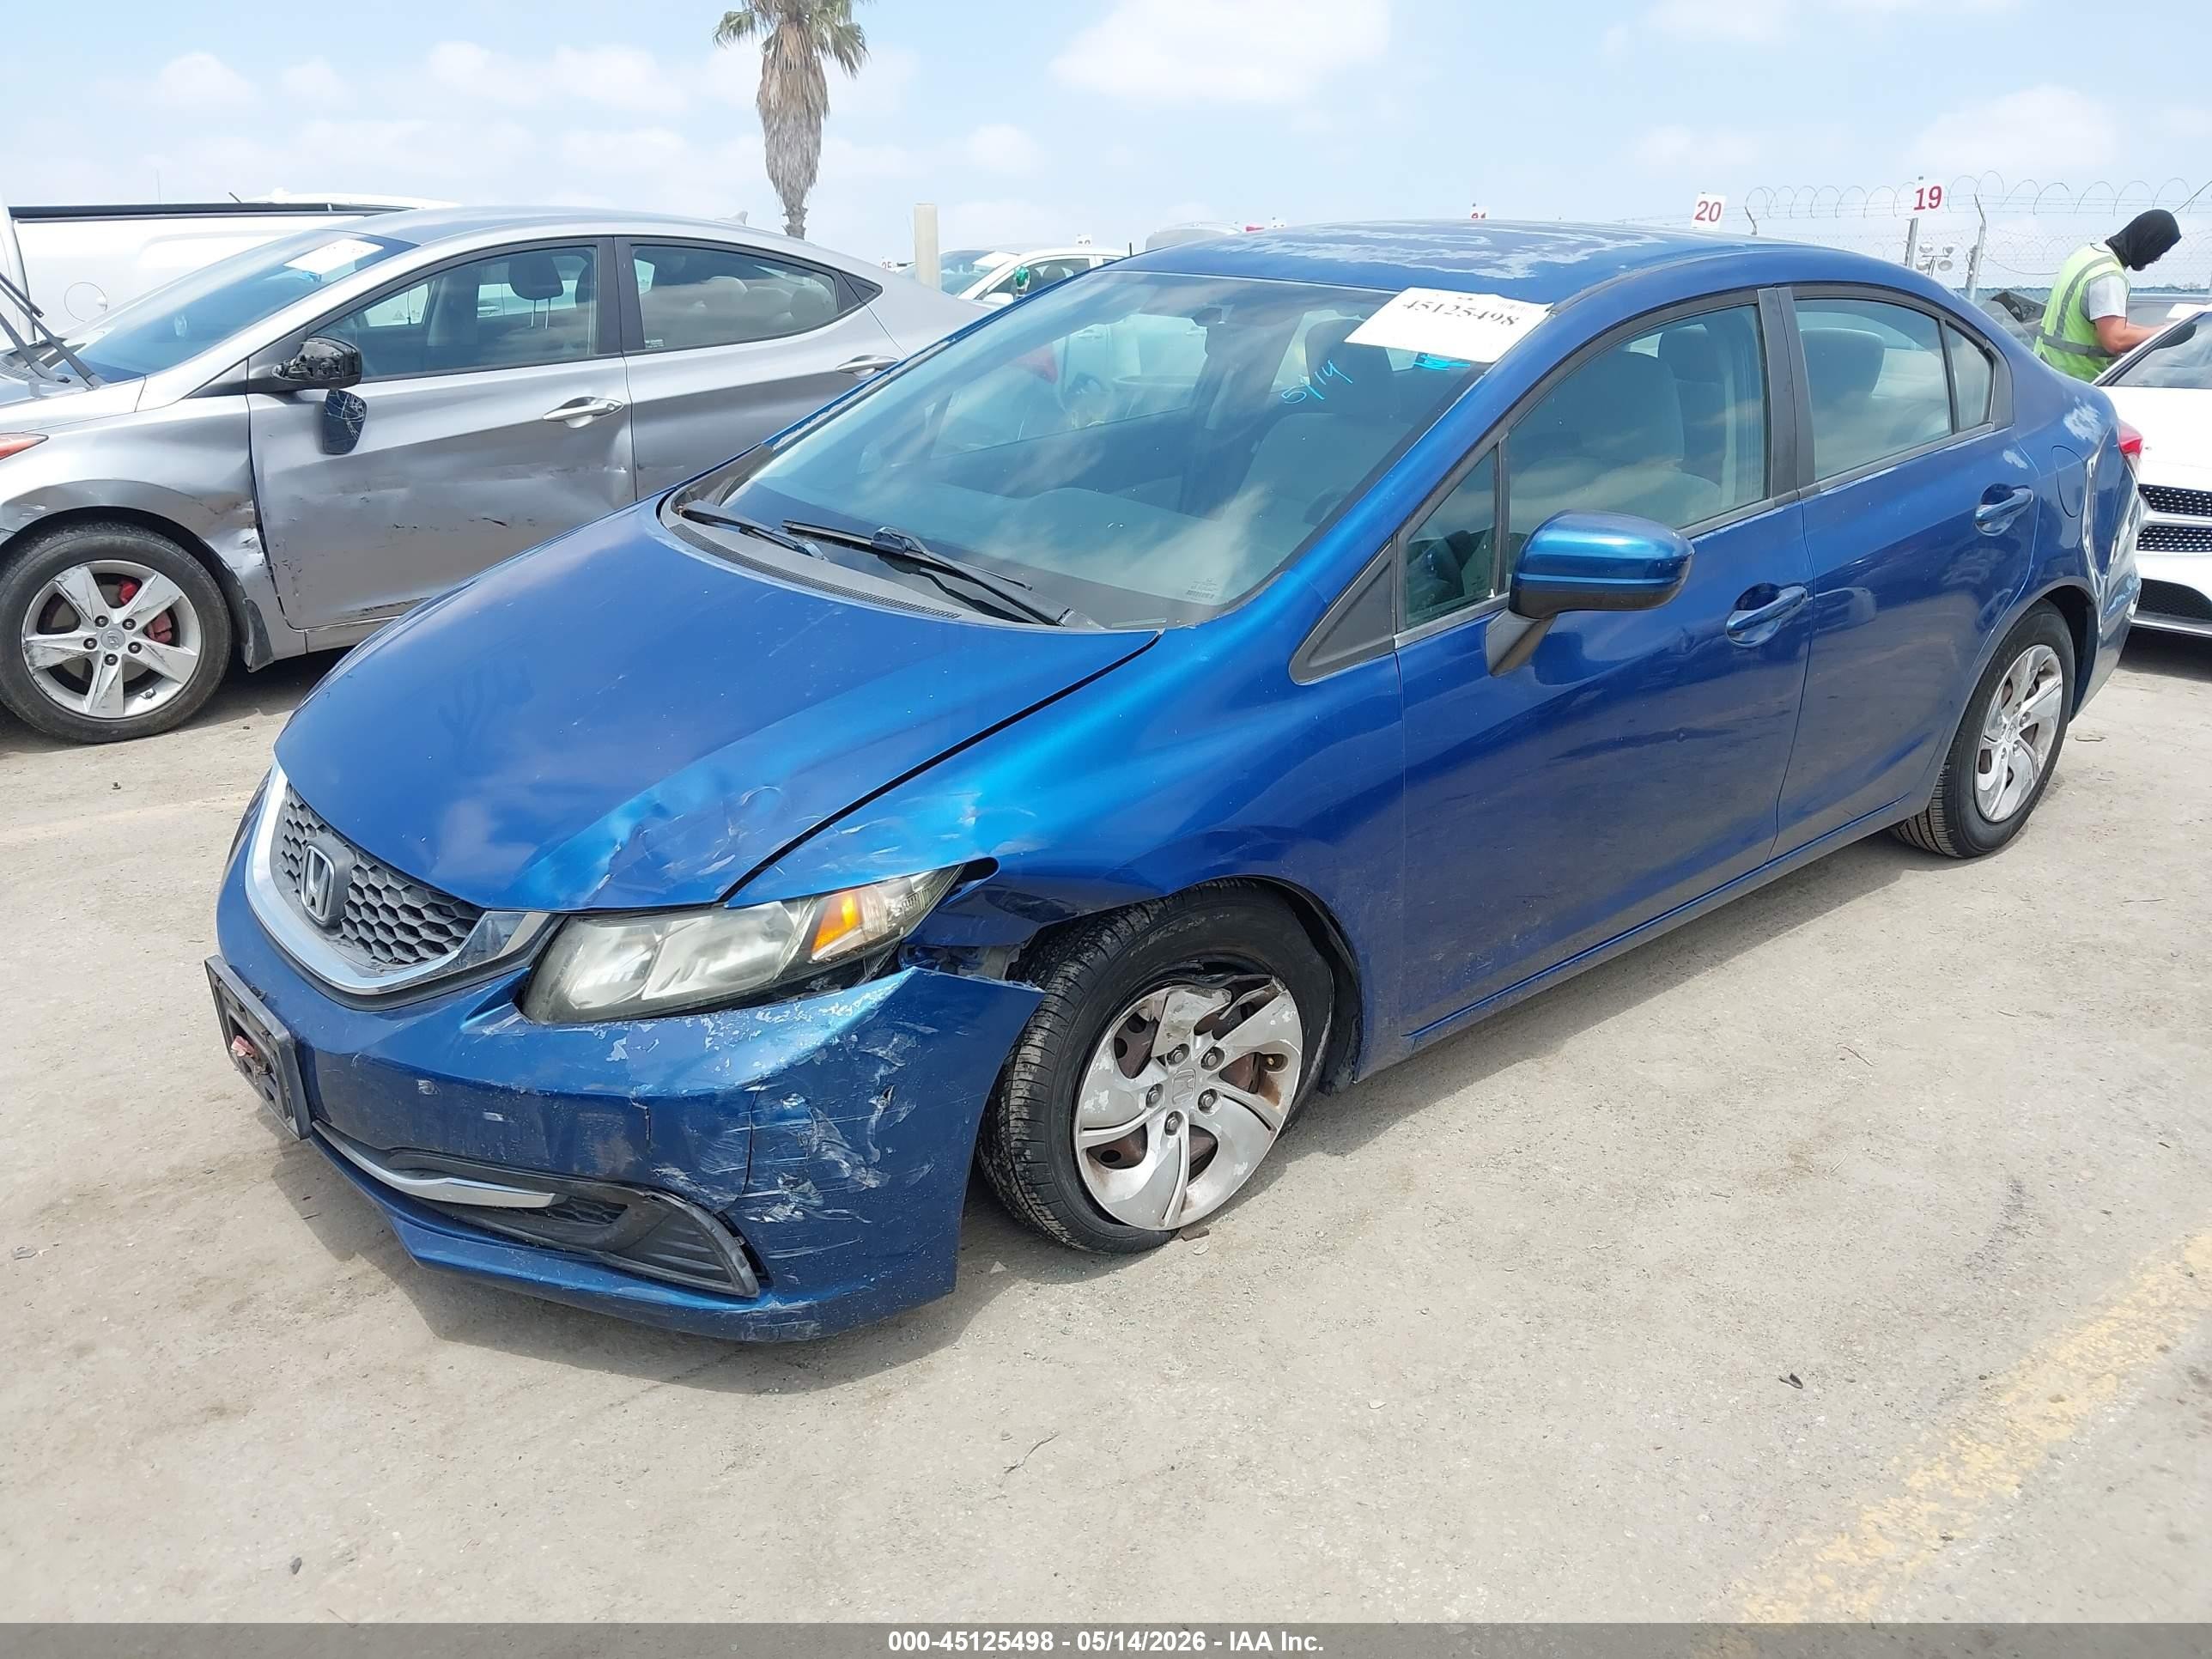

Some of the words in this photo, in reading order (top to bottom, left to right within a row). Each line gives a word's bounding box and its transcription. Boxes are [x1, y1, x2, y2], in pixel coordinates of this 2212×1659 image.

[1913, 185, 1942, 210] 19
[1694, 200, 1722, 222] 20
[1403, 301, 1521, 325] 45125498
